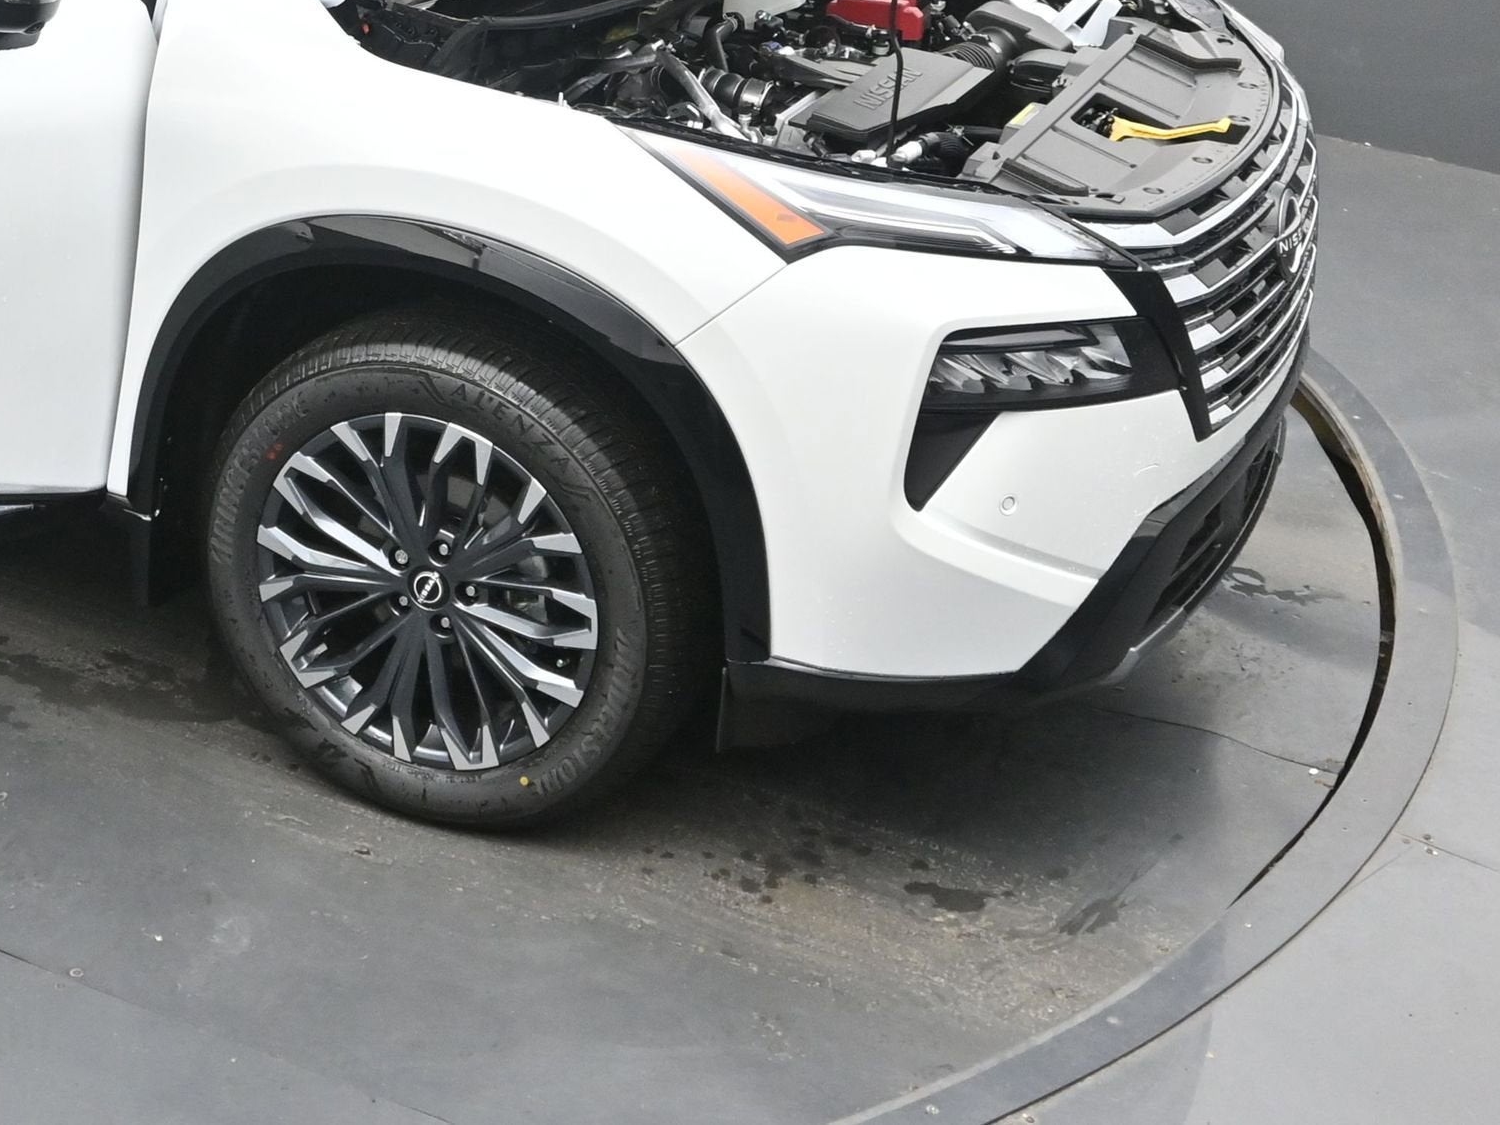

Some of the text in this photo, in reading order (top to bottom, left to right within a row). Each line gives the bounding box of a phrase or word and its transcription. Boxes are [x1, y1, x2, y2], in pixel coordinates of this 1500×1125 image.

[852, 67, 924, 111] NISSAN
[1278, 228, 1303, 255] NISS
[450, 382, 570, 475] ALENZA
